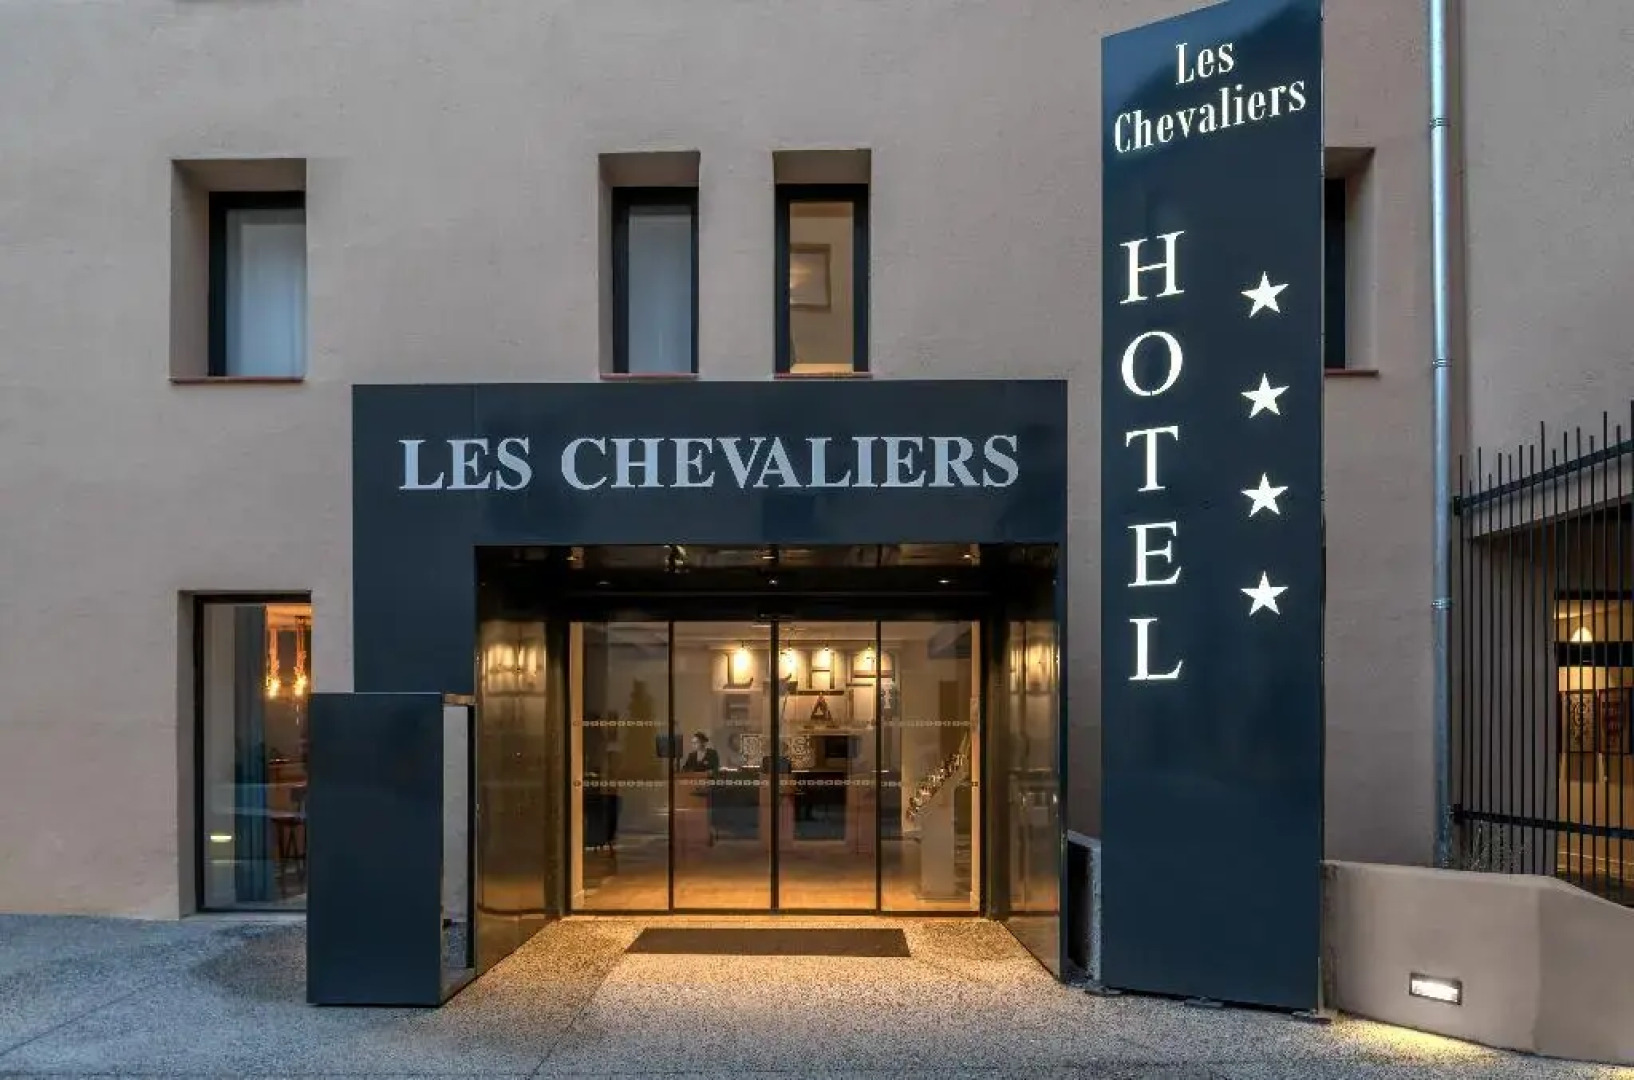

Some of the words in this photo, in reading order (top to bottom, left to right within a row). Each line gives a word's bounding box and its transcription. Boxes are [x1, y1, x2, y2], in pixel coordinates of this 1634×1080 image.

[1176, 42, 1235, 87] Les
[1115, 81, 1306, 154] Chevaliers
[399, 437, 532, 491] LES
[561, 435, 1020, 490] CHEVALIERS
[1120, 231, 1185, 683] HOTEL
